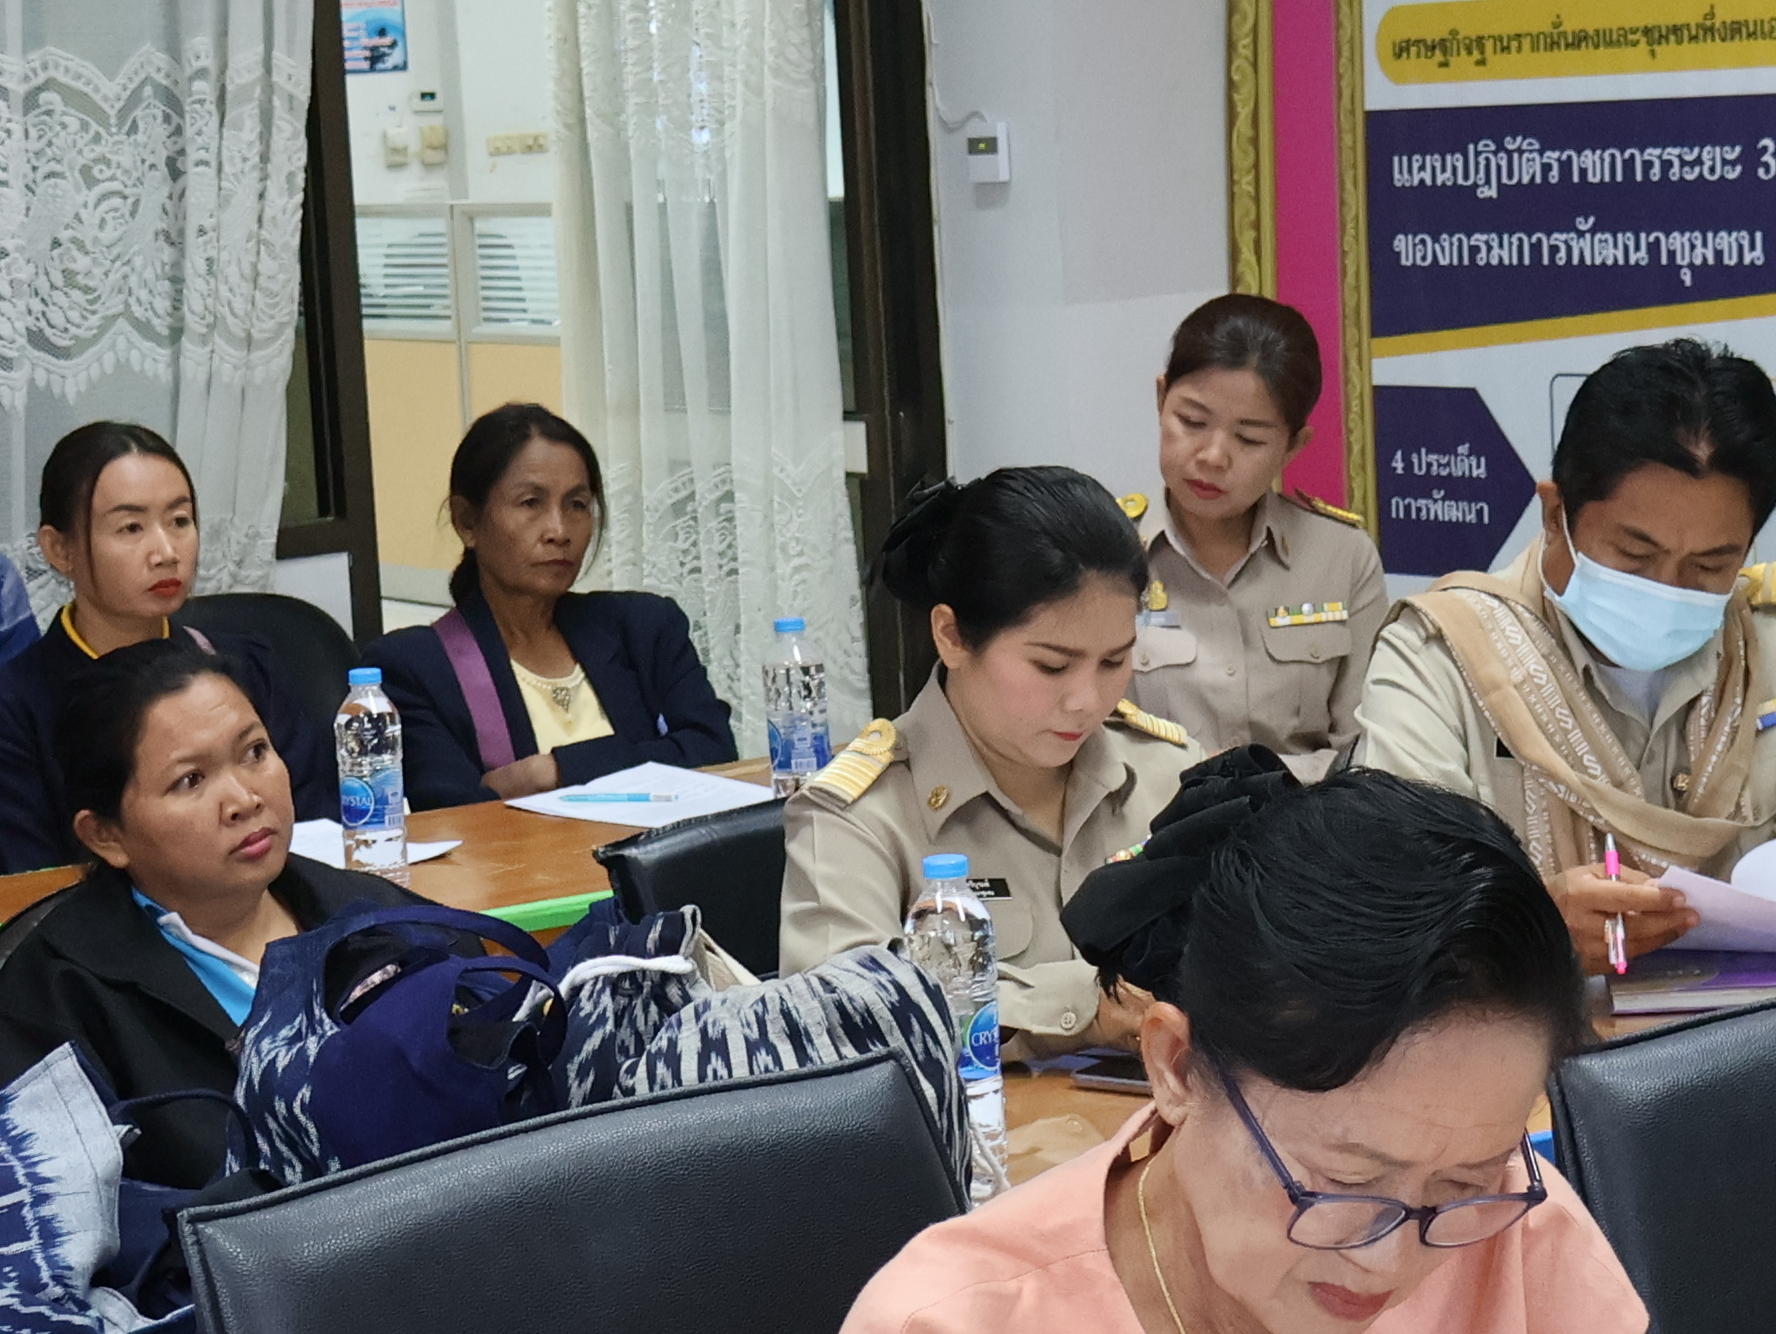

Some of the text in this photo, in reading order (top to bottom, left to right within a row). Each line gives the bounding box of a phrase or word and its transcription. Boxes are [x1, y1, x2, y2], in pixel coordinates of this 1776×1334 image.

[1391, 135, 1743, 199] แผนปฏิบัติราชการระยะ
[1392, 215, 1765, 288] ของกรมการพัฒนาชุมชน
[1391, 442, 1488, 479] 4 ประเด็น
[1391, 489, 1490, 525] การพัฒนา
